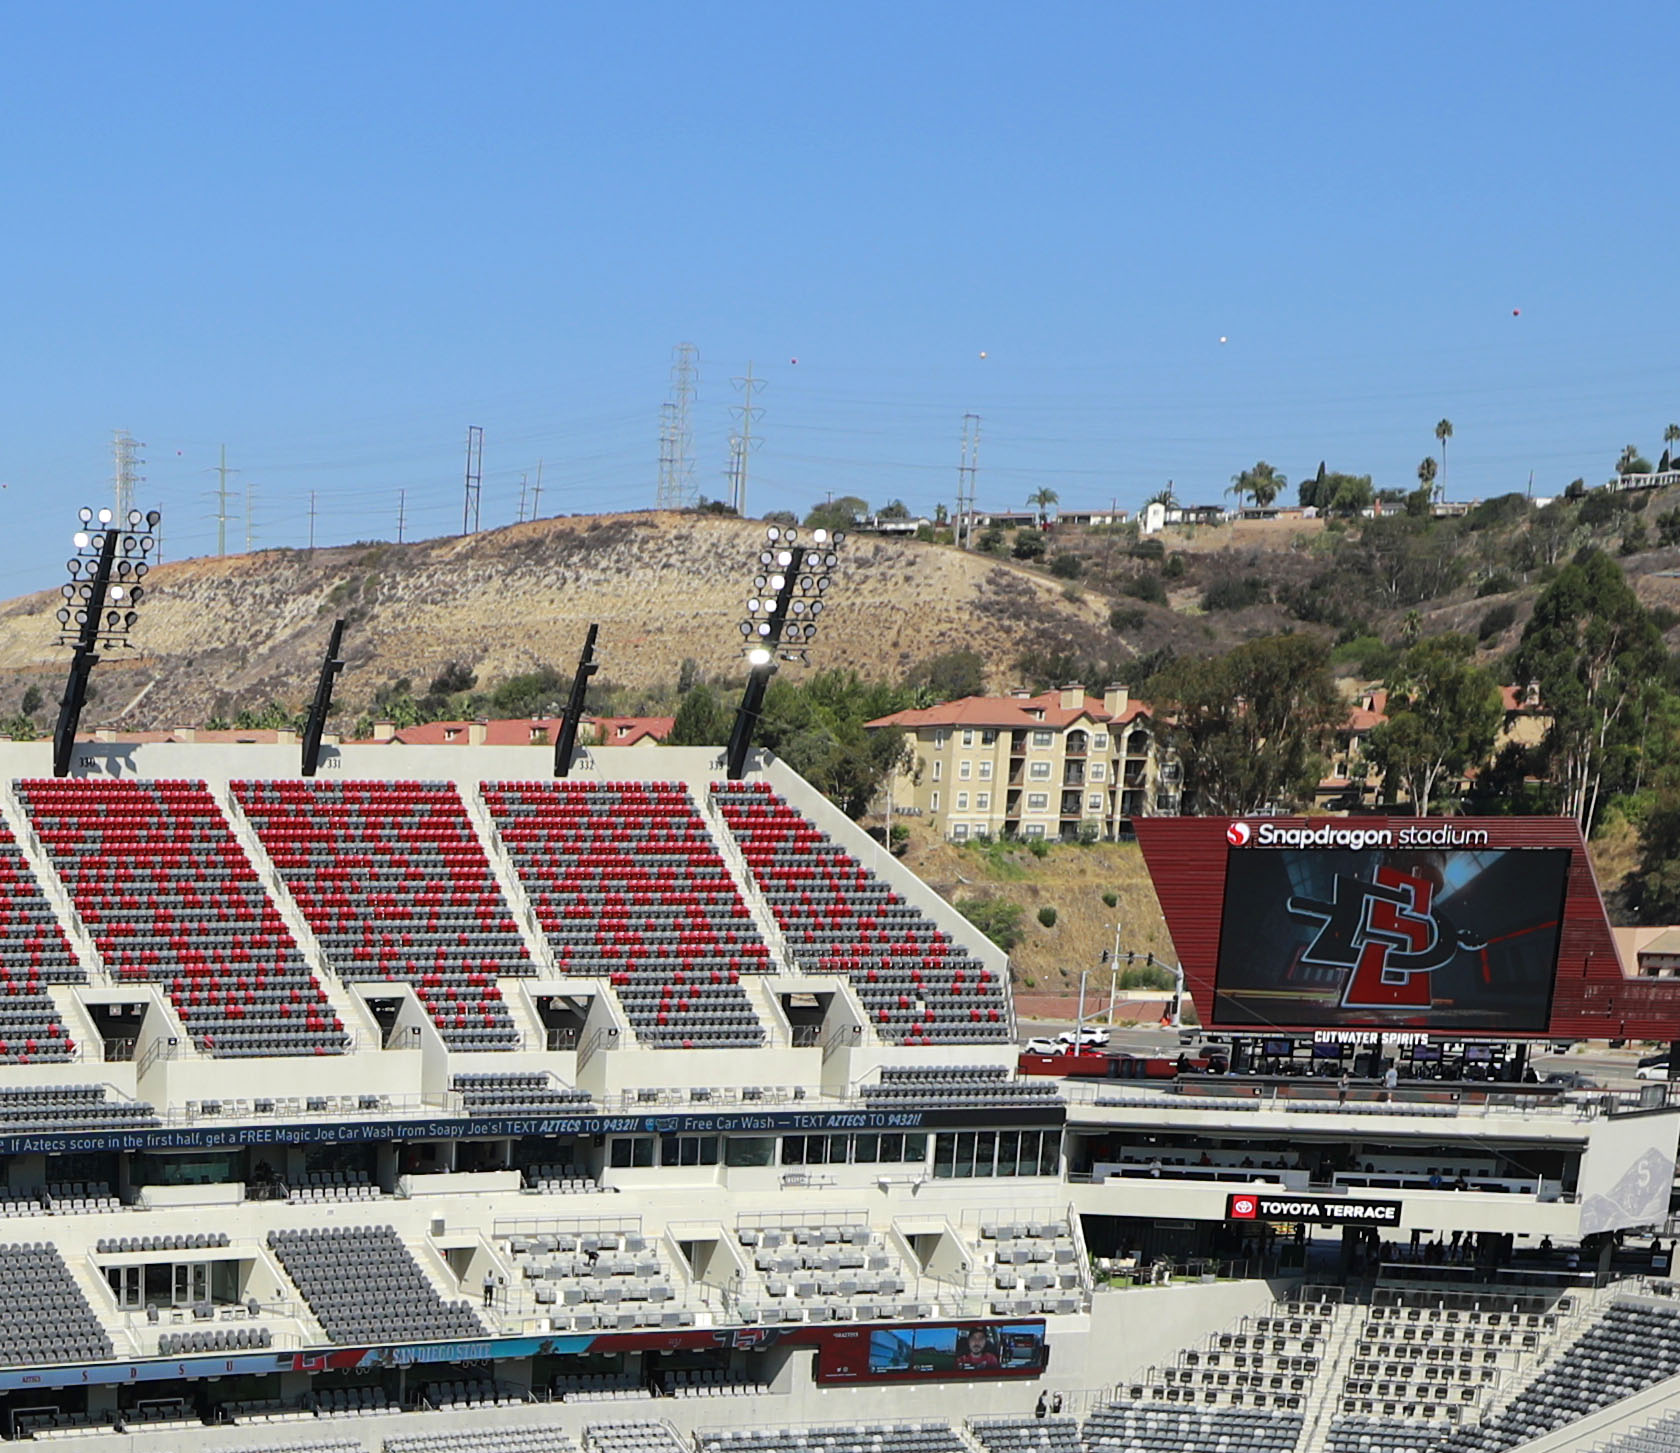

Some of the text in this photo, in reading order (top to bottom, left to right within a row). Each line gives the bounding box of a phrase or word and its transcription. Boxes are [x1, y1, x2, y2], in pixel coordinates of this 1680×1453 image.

[79, 757, 95, 768] 330
[328, 758, 341, 768] 331
[580, 760, 594, 769] 332
[1258, 823, 1488, 849] Snapdragon stadium
[1314, 1031, 1429, 1045] CUTWATER SPIRITS
[685, 1117, 712, 1130] Free
[717, 1117, 737, 1130] Car
[742, 1116, 774, 1129] Wash
[794, 1115, 824, 1128] TEXT
[827, 1114, 866, 1127] AZTECS
[869, 1113, 885, 1126] TO
[12, 1119, 599, 1151] If Aztecs score in the first half, get a FREE Magic Joe Car Wash from Soapy Joe's! TEXT AZTECS TO
[1260, 1201, 1396, 1219] TOYOTA TERRACE
[393, 1343, 492, 1364] SAN DIEGO STATE
